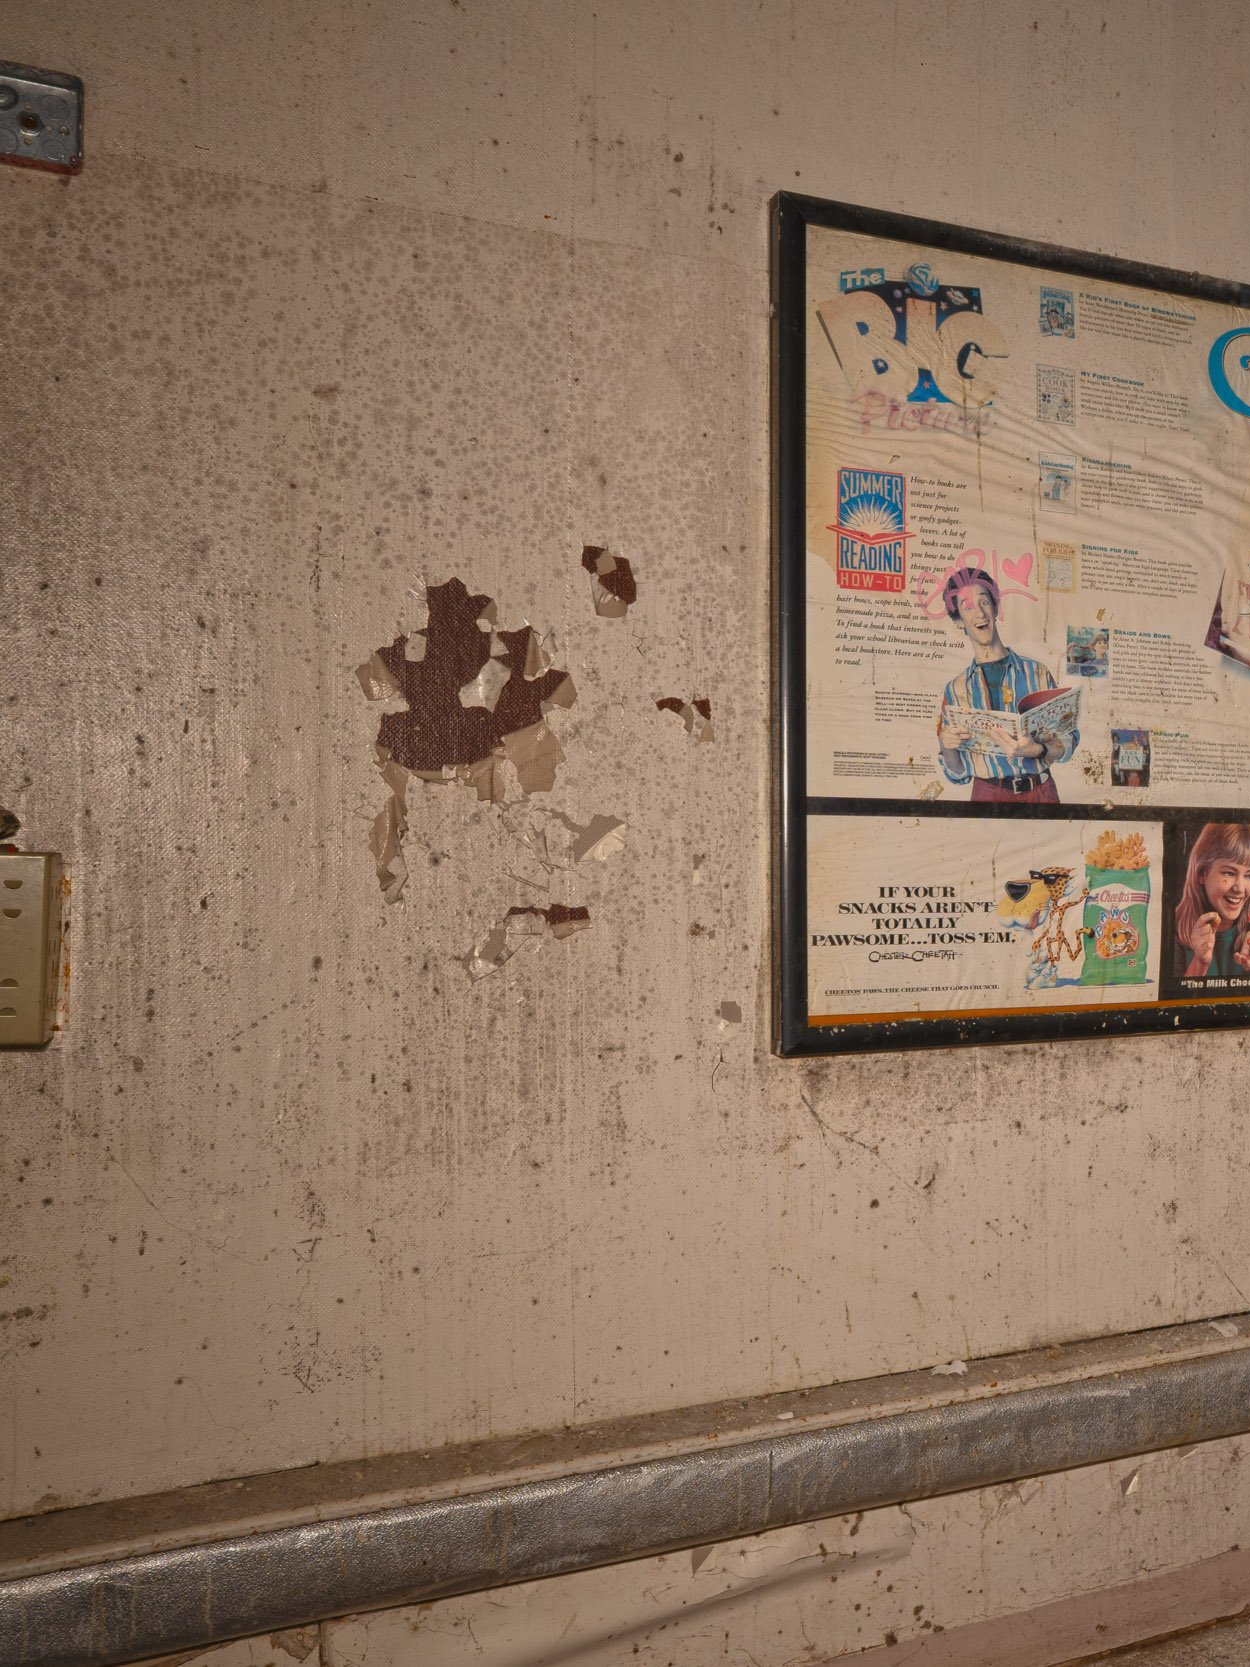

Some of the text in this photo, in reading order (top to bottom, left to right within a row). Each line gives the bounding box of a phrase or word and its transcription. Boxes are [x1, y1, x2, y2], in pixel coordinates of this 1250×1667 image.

[842, 270, 882, 289] The
[1104, 297, 1122, 305] FIRST
[1124, 301, 1140, 310] BOOK
[1092, 373, 1110, 381] FIRST
[1112, 376, 1144, 387] COOKBOOK
[910, 476, 935, 485] How-to
[937, 479, 954, 488] books
[840, 471, 904, 509] SUMMER
[921, 490, 936, 498] just
[936, 491, 947, 499] for
[911, 501, 959, 513] science projects
[919, 515, 935, 524] goofy
[937, 517, 962, 526] gadget-
[920, 526, 940, 535] lovers.
[949, 528, 958, 537] lot
[959, 530, 967, 539] of
[921, 538, 938, 547] books
[953, 542, 965, 550] tell
[1081, 543, 1108, 552] SIGNING
[839, 536, 903, 573] READING
[924, 551, 938, 559] how
[910, 563, 946, 573] things just
[840, 572, 902, 590] HOW-TO
[836, 594, 851, 602] hair
[854, 596, 872, 605] bows,
[874, 599, 892, 607] scope
[893, 598, 912, 608] birds,
[836, 606, 873, 616] homemade
[875, 610, 895, 619] pizza,
[897, 612, 911, 620] and
[835, 619, 845, 627] To
[845, 620, 863, 629] find
[870, 622, 885, 630] book
[887, 623, 902, 631] that
[903, 625, 932, 634] interests
[1114, 629, 1137, 637] BRAIDS
[867, 634, 887, 642] school
[888, 635, 920, 645] librarian
[929, 640, 947, 648] check
[949, 641, 965, 649] with
[842, 644, 859, 653] local
[859, 646, 892, 655] bookstore.
[894, 649, 912, 657] Here
[931, 651, 944, 660] few
[843, 658, 861, 666] read.
[1121, 755, 1141, 764] FUN
[878, 885, 956, 898] IF YOUR
[1100, 889, 1130, 903] Cheetos
[838, 901, 995, 914] SNACKS AREN'T
[872, 917, 960, 930] TOTALLY
[1095, 909, 1130, 939] PAWS
[978, 931, 1017, 945] 'EM.
[868, 949, 962, 963] CHESTER CHEETAH
[1206, 979, 1228, 988] Milk
